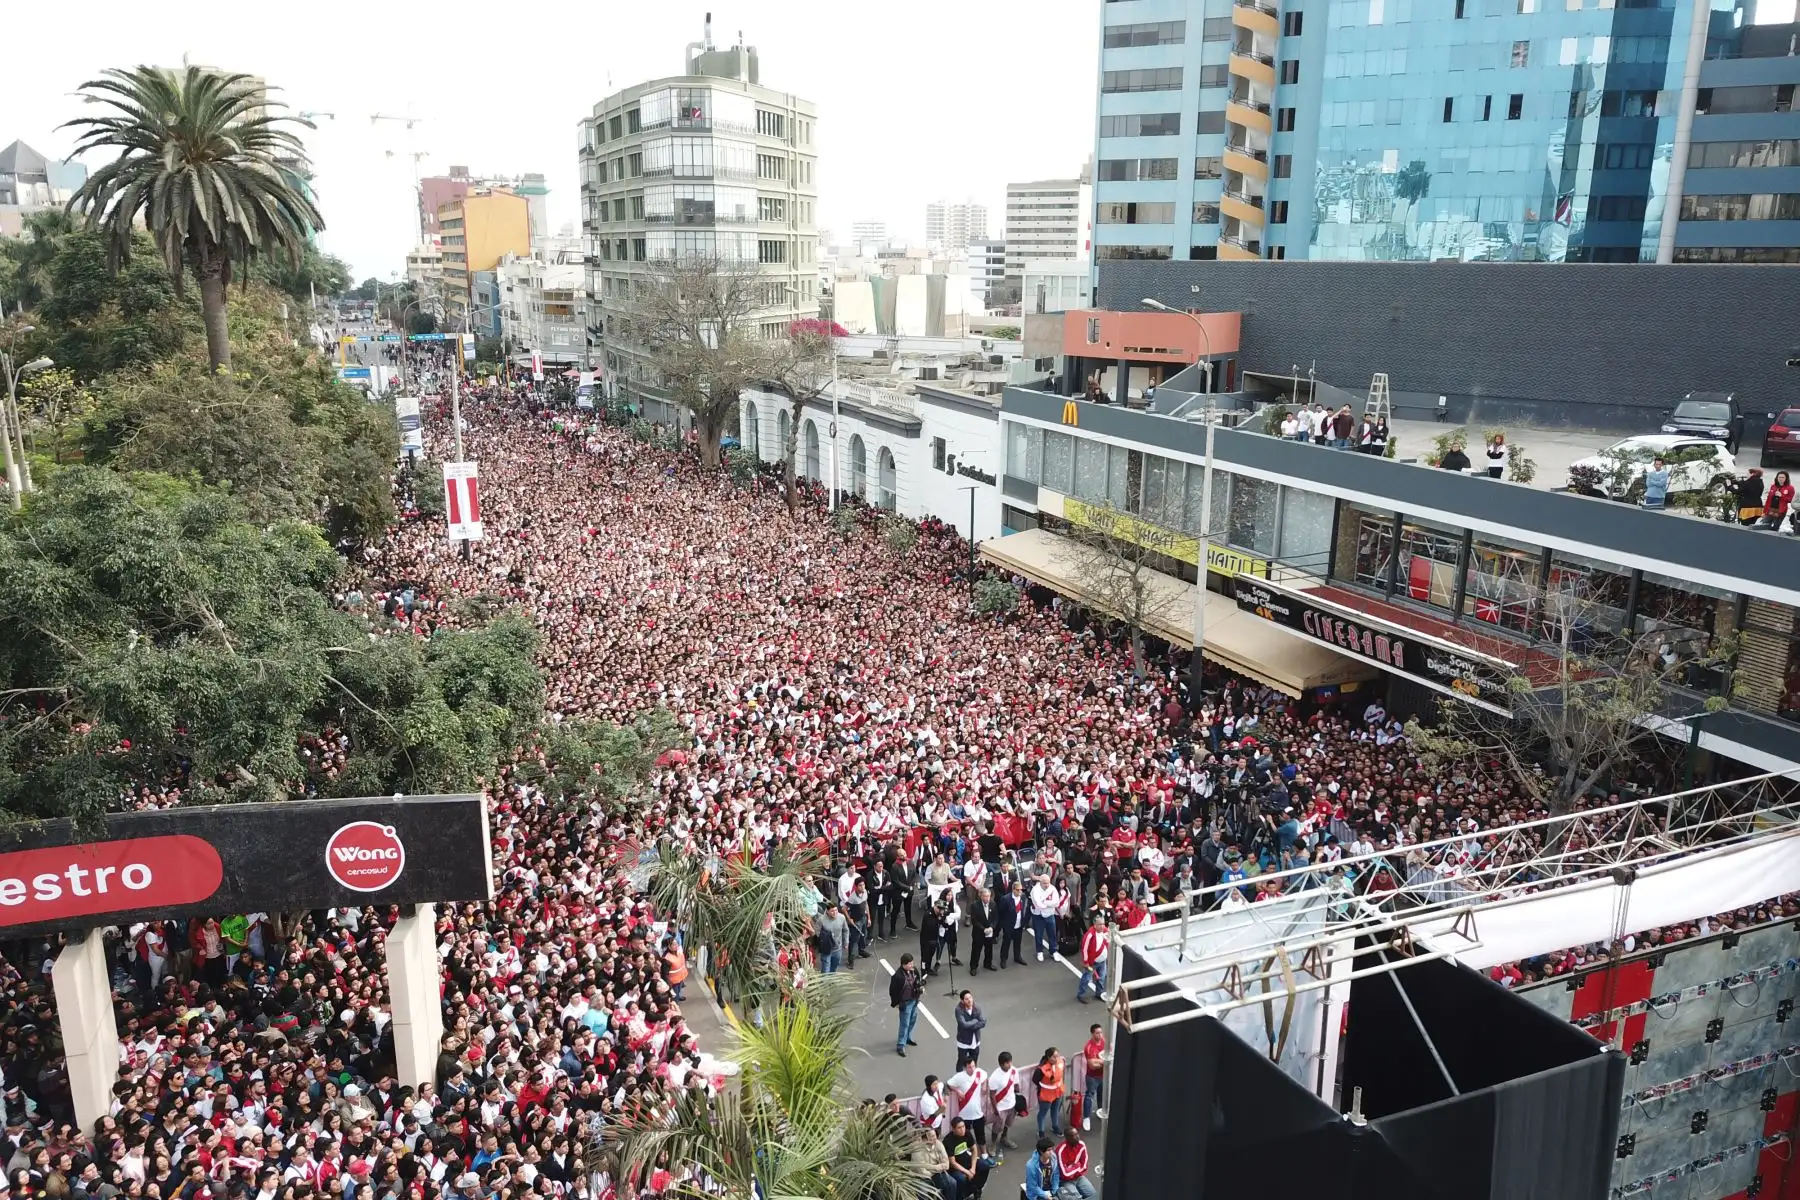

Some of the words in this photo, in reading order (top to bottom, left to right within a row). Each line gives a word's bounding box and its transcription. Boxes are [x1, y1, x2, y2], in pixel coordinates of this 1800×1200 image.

[1207, 549, 1242, 573] HAITI
[1236, 589, 1259, 606] Digital
[1259, 598, 1290, 616] Cinema
[1252, 586, 1271, 602] Sony
[1255, 606, 1274, 621] 4K
[1303, 609, 1404, 669] CINERAMA
[1426, 658, 1460, 677] Digital
[1449, 655, 1475, 672] Sony
[347, 866, 388, 876] cencosud
[0, 863, 152, 906] estro
